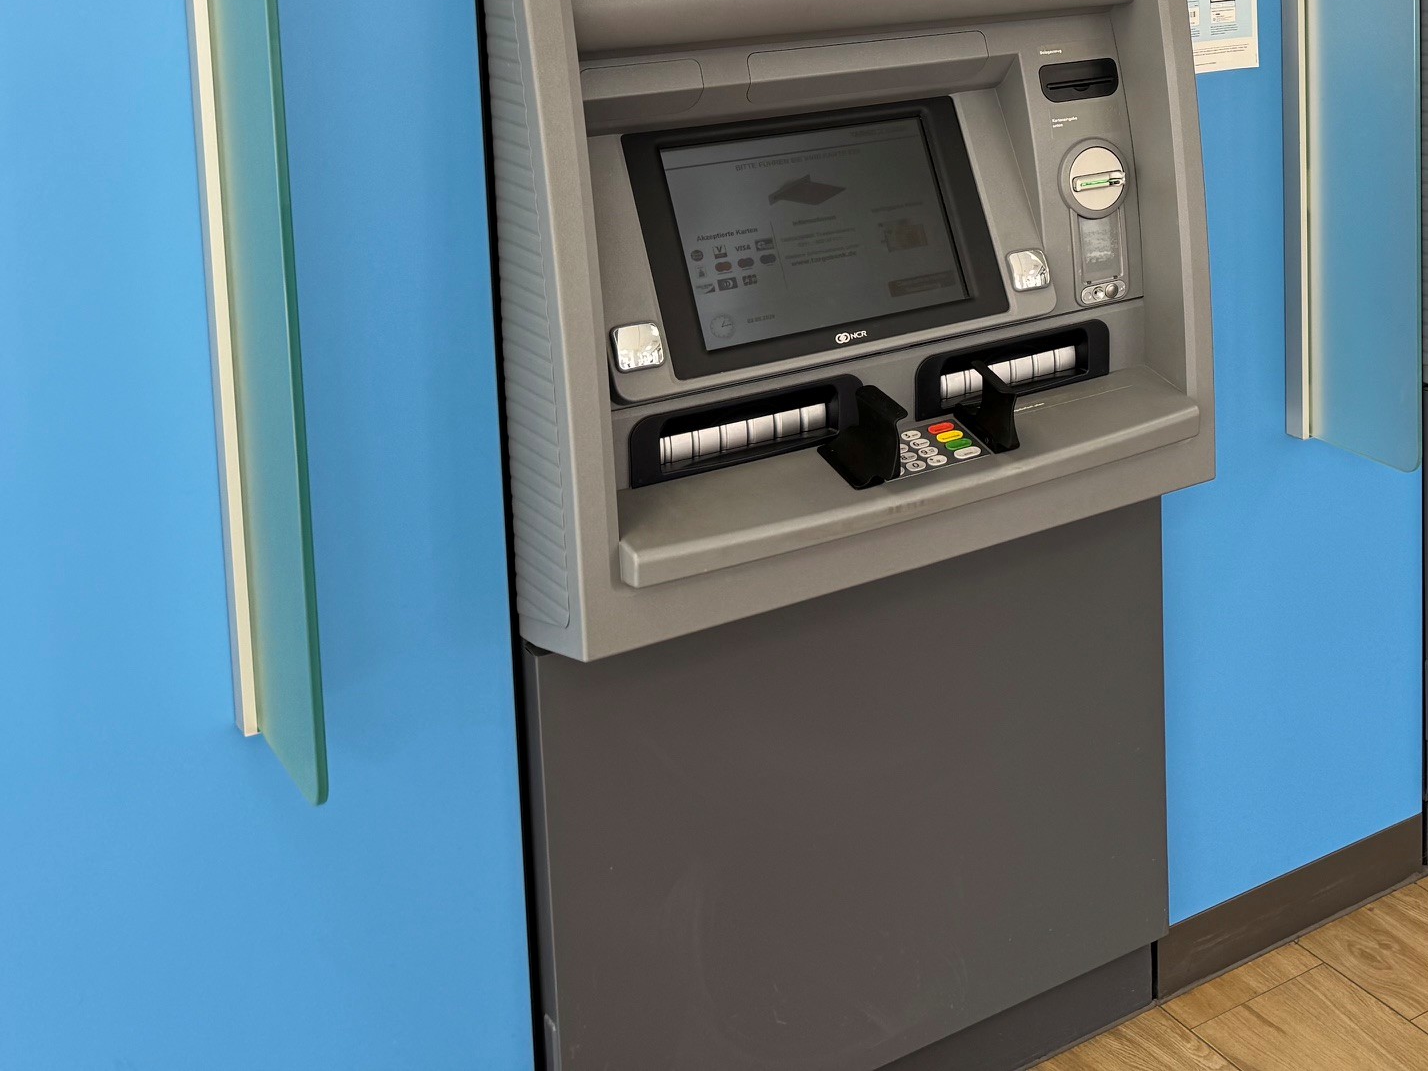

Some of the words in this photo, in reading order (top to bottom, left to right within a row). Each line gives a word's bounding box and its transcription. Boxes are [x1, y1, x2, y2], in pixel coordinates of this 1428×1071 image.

[697, 229, 734, 242] Akzeptierte
[735, 227, 758, 236] Karten
[735, 244, 751, 252] VISA
[850, 330, 868, 340] NCR
